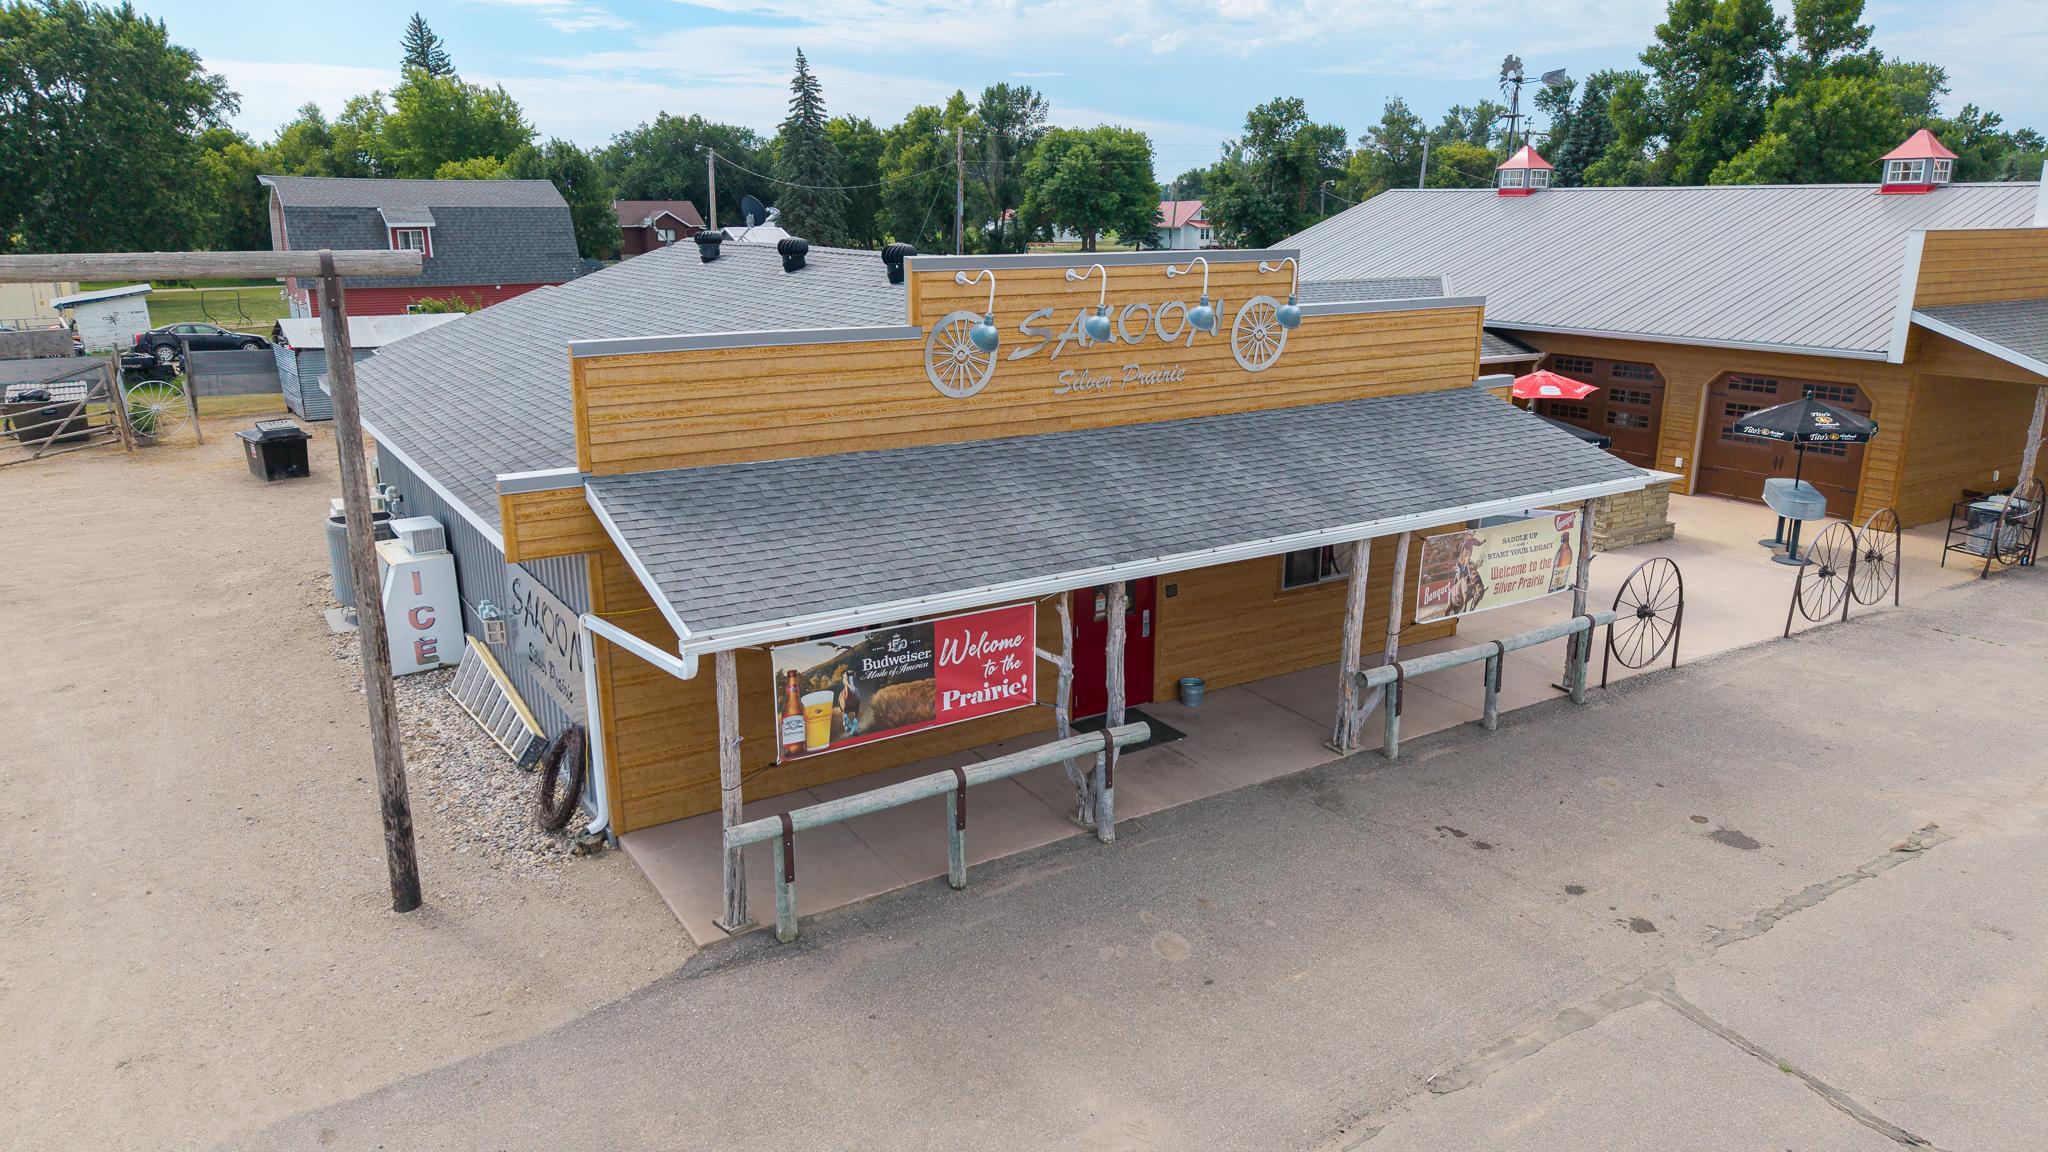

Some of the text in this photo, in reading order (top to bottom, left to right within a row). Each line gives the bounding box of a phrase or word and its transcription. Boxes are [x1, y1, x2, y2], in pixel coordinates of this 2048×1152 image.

[1008, 296, 1224, 361] SAOON
[1054, 363, 1185, 395] Silver Prairie
[1743, 426, 1761, 435] Tito's
[1810, 433, 1830, 441] Tito's
[1502, 532, 1539, 544] SADDLE UP
[1488, 542, 1554, 560] START YOUR LEGACY
[1491, 557, 1552, 580] Welcome to the
[1423, 582, 1452, 606] Banquet
[1493, 579, 1516, 596] Silver
[1518, 573, 1544, 590] Prairie
[408, 570, 440, 666] ICE
[512, 577, 583, 673] SALOON
[939, 629, 1025, 666] Welcome
[860, 661, 929, 680] Made of America
[981, 653, 1023, 679] to the
[941, 674, 1028, 711] Prairie!
